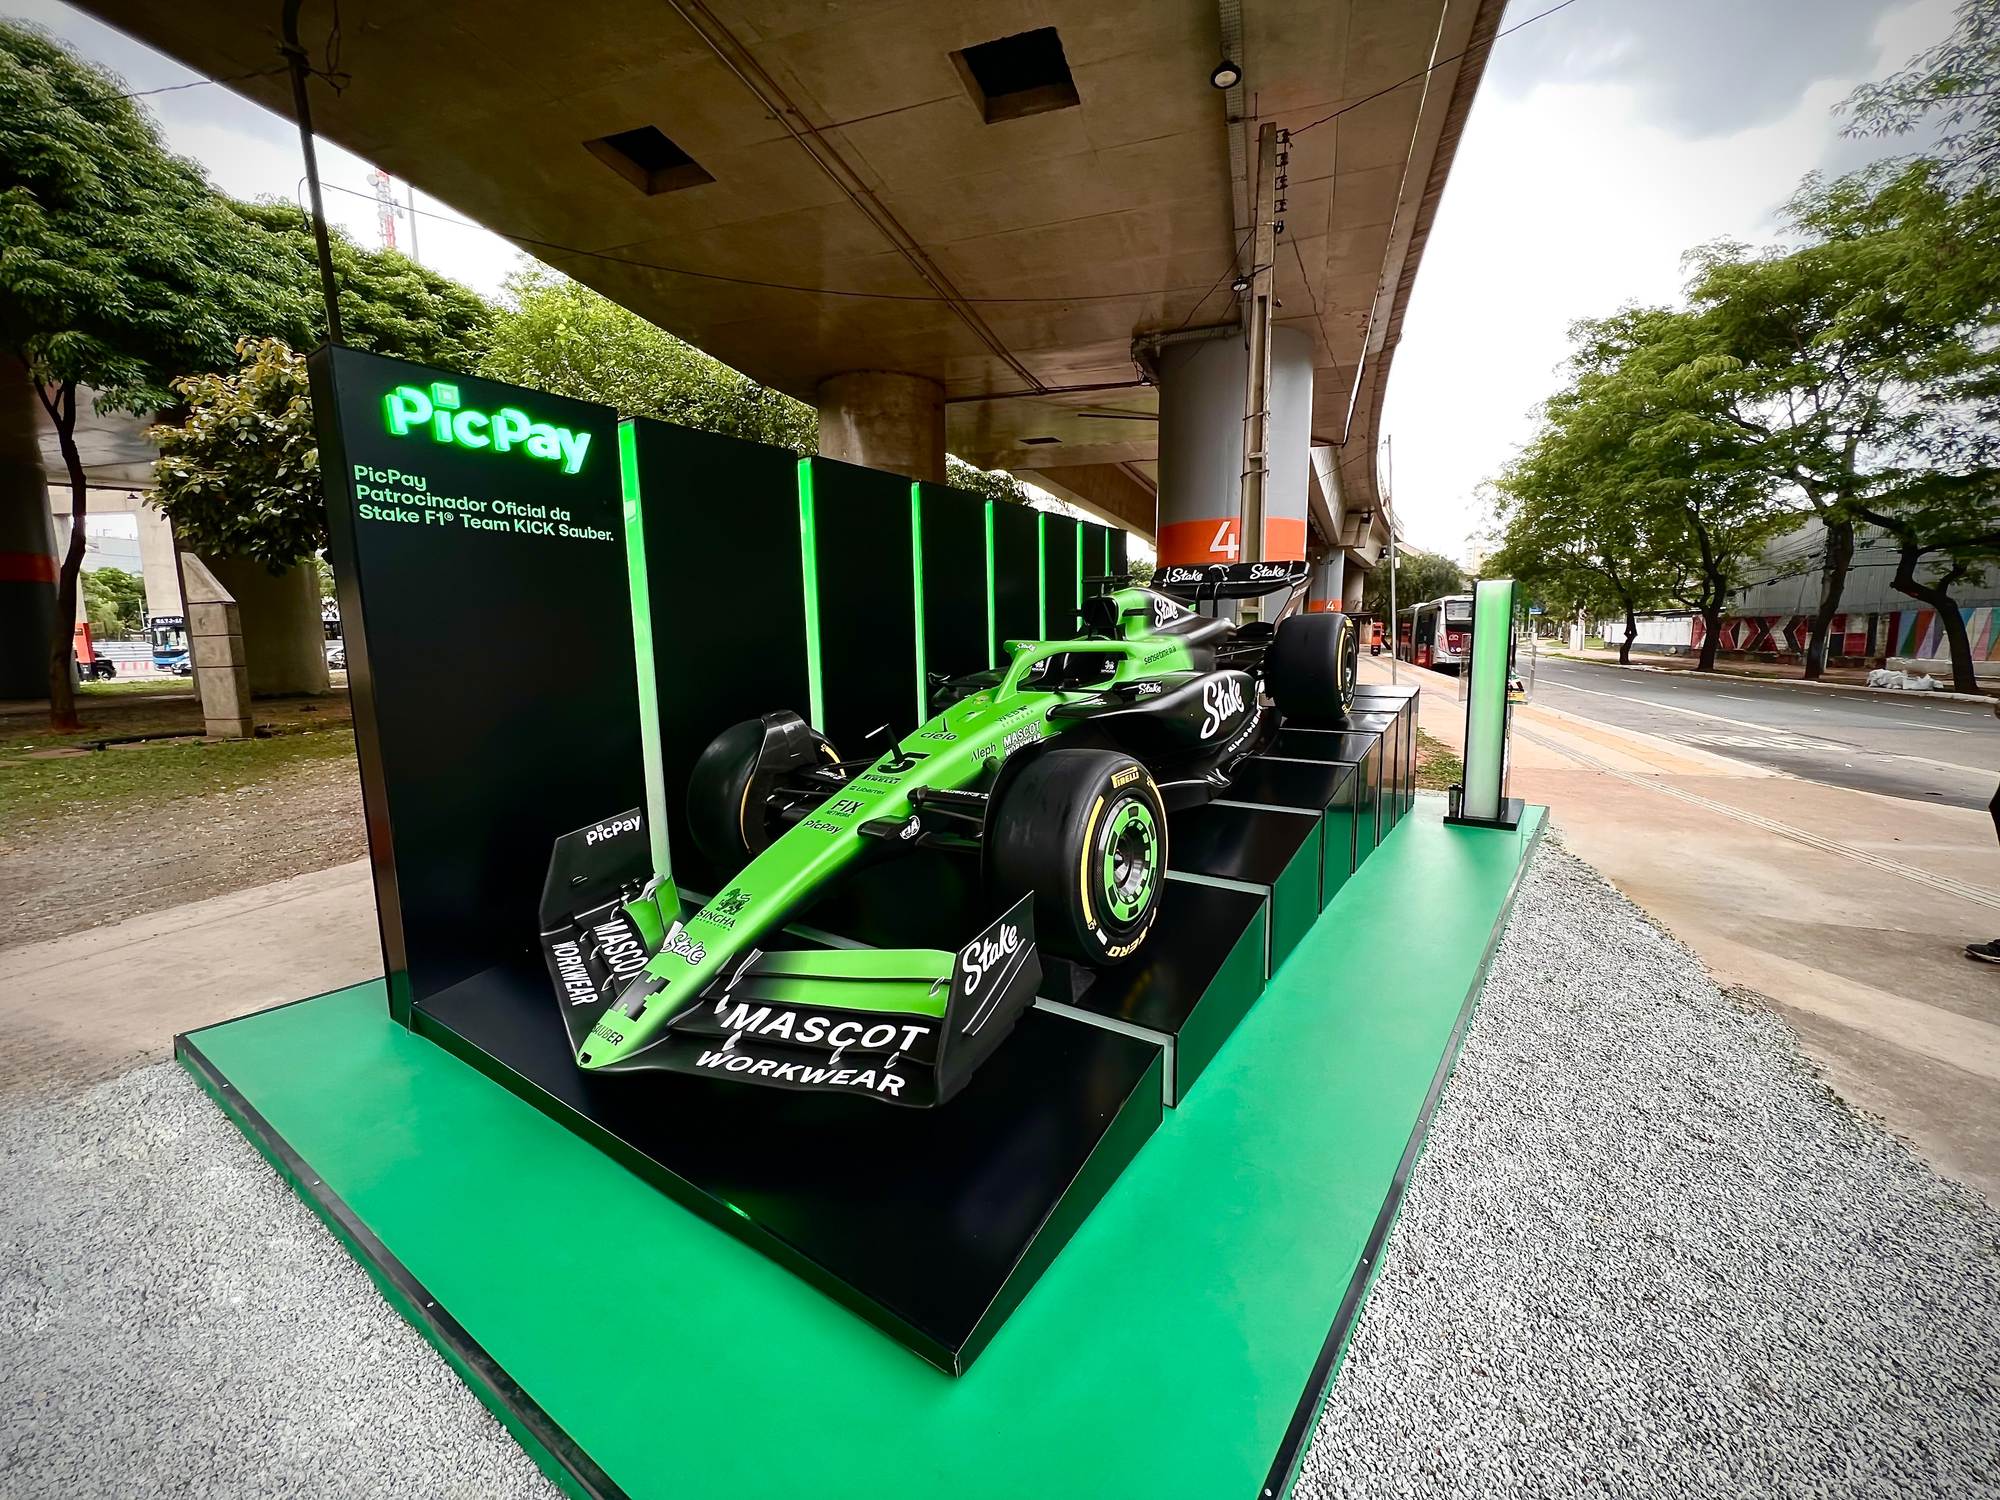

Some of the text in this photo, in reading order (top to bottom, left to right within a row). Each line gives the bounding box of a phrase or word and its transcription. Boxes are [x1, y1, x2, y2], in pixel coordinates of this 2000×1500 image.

[384, 382, 592, 474] PicPay
[354, 465, 427, 491] PicPay
[356, 484, 570, 521] Patrocinador Oficial da
[359, 504, 420, 525] Stake
[460, 514, 510, 532] Team
[514, 520, 556, 537] KICK
[559, 523, 614, 542] Sauber.
[1210, 521, 1239, 559] 4
[1171, 568, 1203, 582] Stake
[1250, 564, 1285, 580] Stake
[1154, 598, 1179, 627] Stake
[1326, 601, 1335, 611] 4
[1138, 682, 1162, 695] Stake
[1200, 675, 1245, 739] Stake
[1003, 720, 1040, 748] MASCOT
[971, 742, 996, 762] Aleph
[1111, 766, 1139, 789] PIRELLI
[825, 809, 852, 818] NETWORK
[831, 799, 865, 813] FIX
[586, 815, 641, 845] PicPay
[803, 820, 843, 834] PicPay
[698, 909, 736, 928] SINGHA
[660, 931, 707, 965] Stake
[962, 923, 1019, 995] Stake
[552, 940, 599, 1006] WORKWEAR
[720, 1004, 930, 1051] MASCOT
[695, 1050, 906, 1096] WORKWEAR
